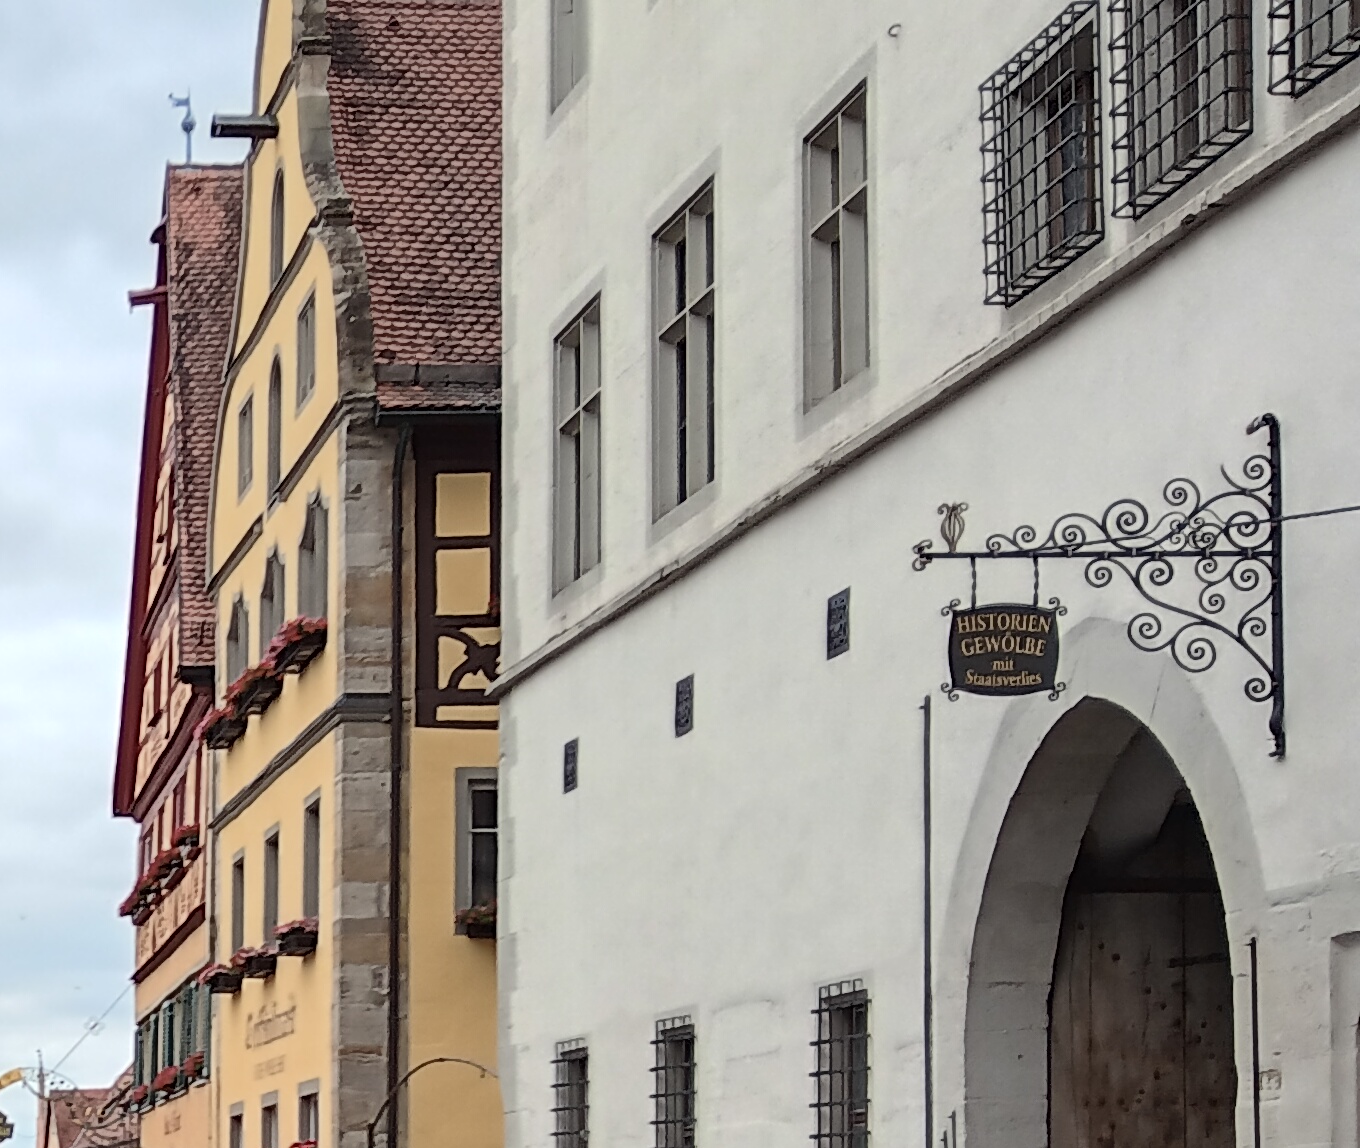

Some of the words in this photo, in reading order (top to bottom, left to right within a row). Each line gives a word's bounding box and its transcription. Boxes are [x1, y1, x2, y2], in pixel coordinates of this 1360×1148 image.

[956, 613, 1052, 634] HISTORIEN
[961, 631, 1047, 657] GEWÖLBE
[992, 656, 1014, 671] mit
[965, 669, 1042, 688] Staatsverlies
